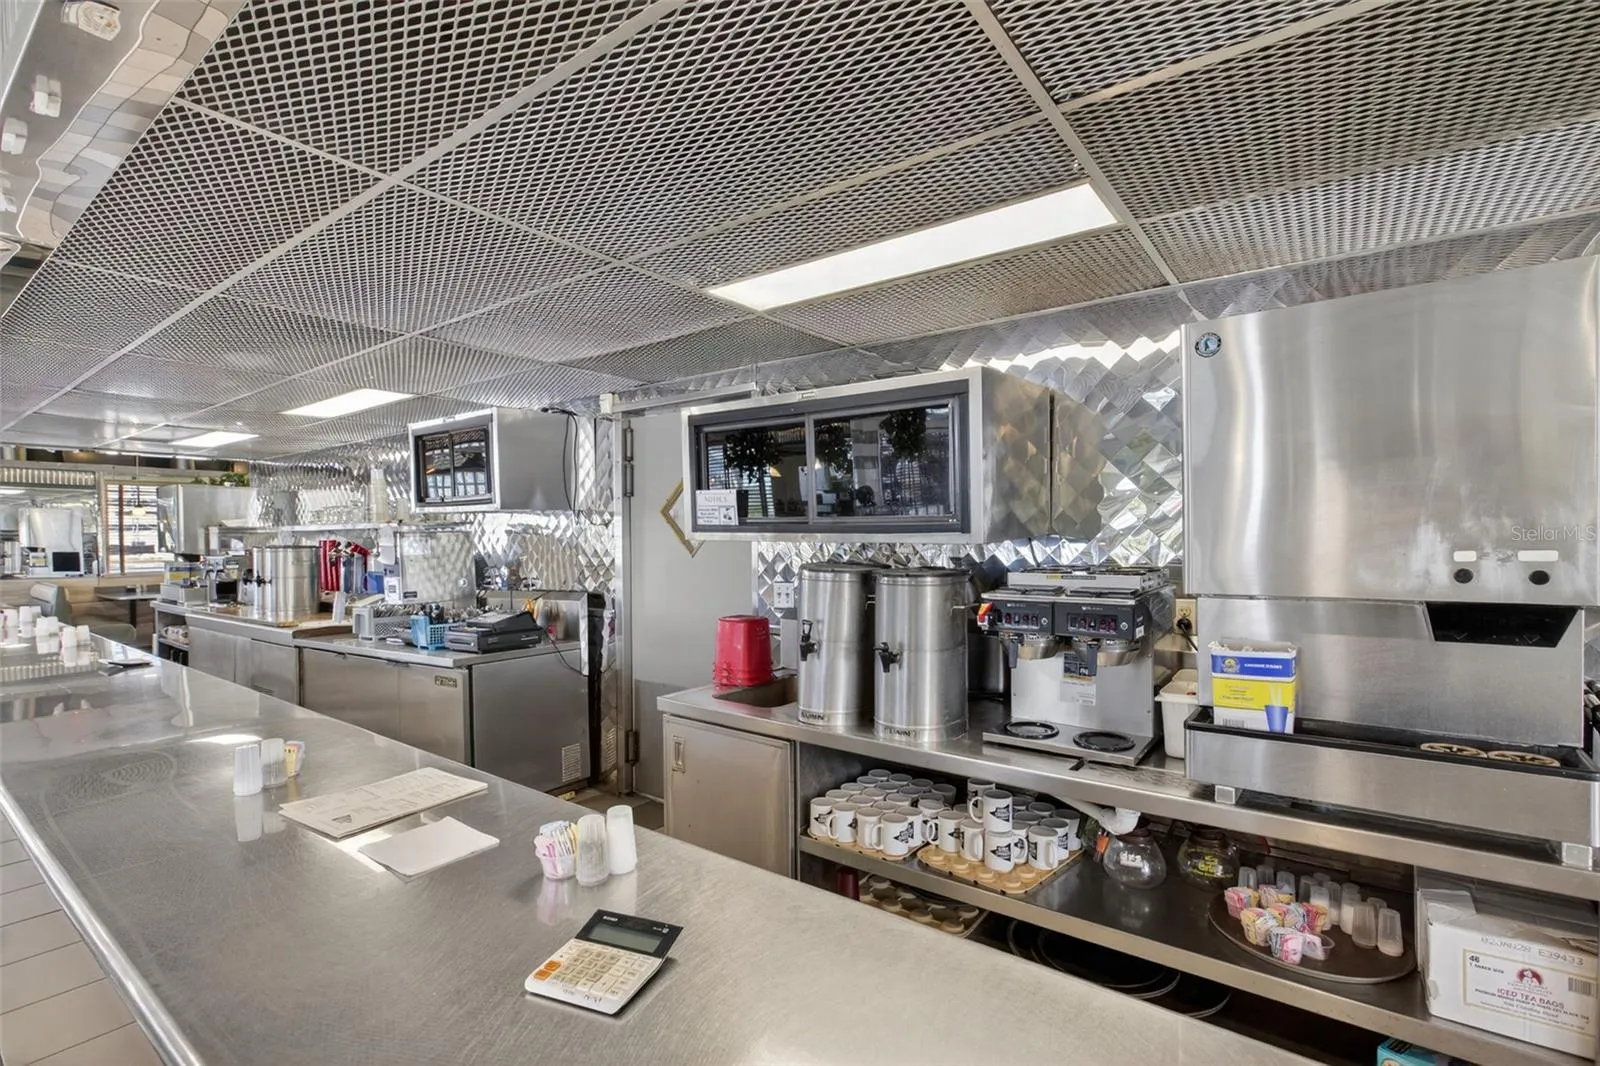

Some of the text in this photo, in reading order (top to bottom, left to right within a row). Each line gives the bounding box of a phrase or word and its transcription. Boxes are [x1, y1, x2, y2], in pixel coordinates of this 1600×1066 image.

[1496, 987, 1518, 998] ICED
[1519, 991, 1537, 1003] TEA
[1538, 995, 1565, 1009] BAGS
